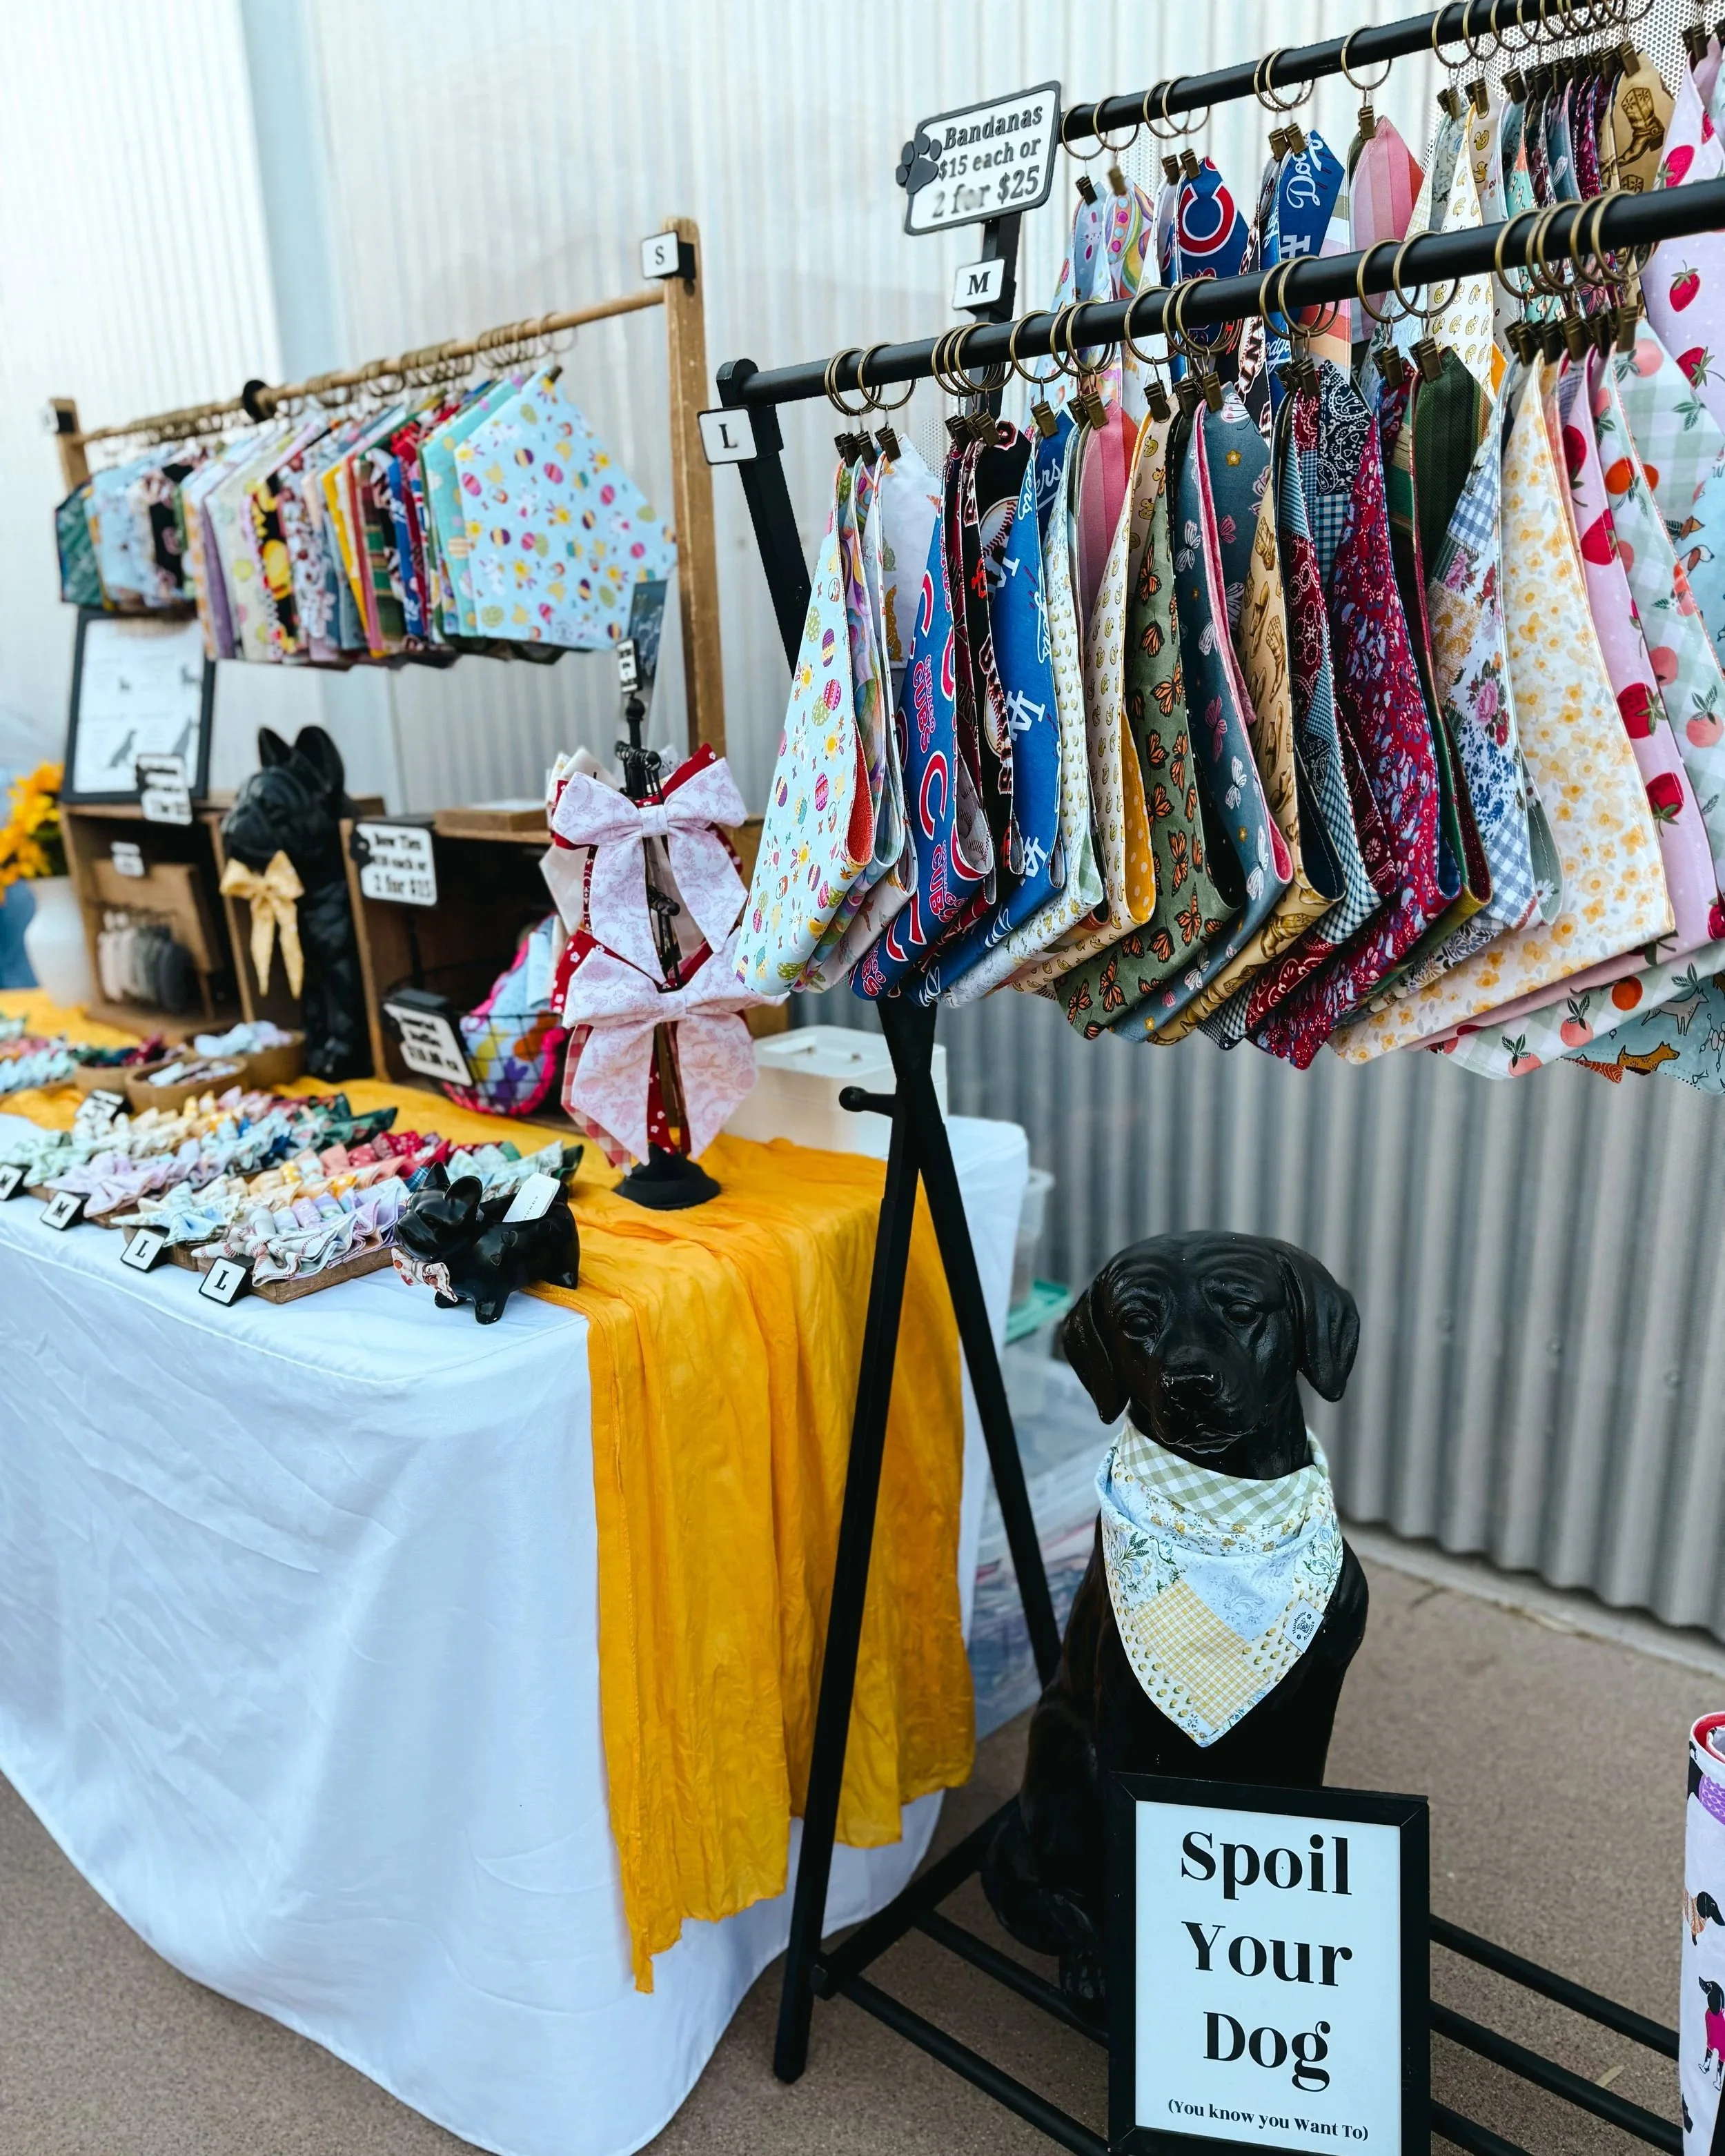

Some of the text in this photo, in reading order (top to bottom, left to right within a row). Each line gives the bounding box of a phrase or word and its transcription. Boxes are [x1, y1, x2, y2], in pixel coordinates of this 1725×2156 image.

[943, 106, 1043, 150] Bandanas
[938, 138, 1041, 181] $15 each or
[931, 165, 1040, 219] 2 for $25
[655, 245, 665, 266] S
[967, 270, 992, 296] M
[719, 423, 738, 450] L
[913, 660, 933, 755] CUBS
[52, 1201, 70, 1218] M
[135, 1239, 150, 1258] L
[214, 1269, 230, 1291] L
[1181, 1831, 1352, 1901] Spoil
[1181, 1921, 1353, 1987] Your
[1203, 2011, 1331, 2093] Dog
[1168, 2099, 1369, 2142] (You know you Want To)
